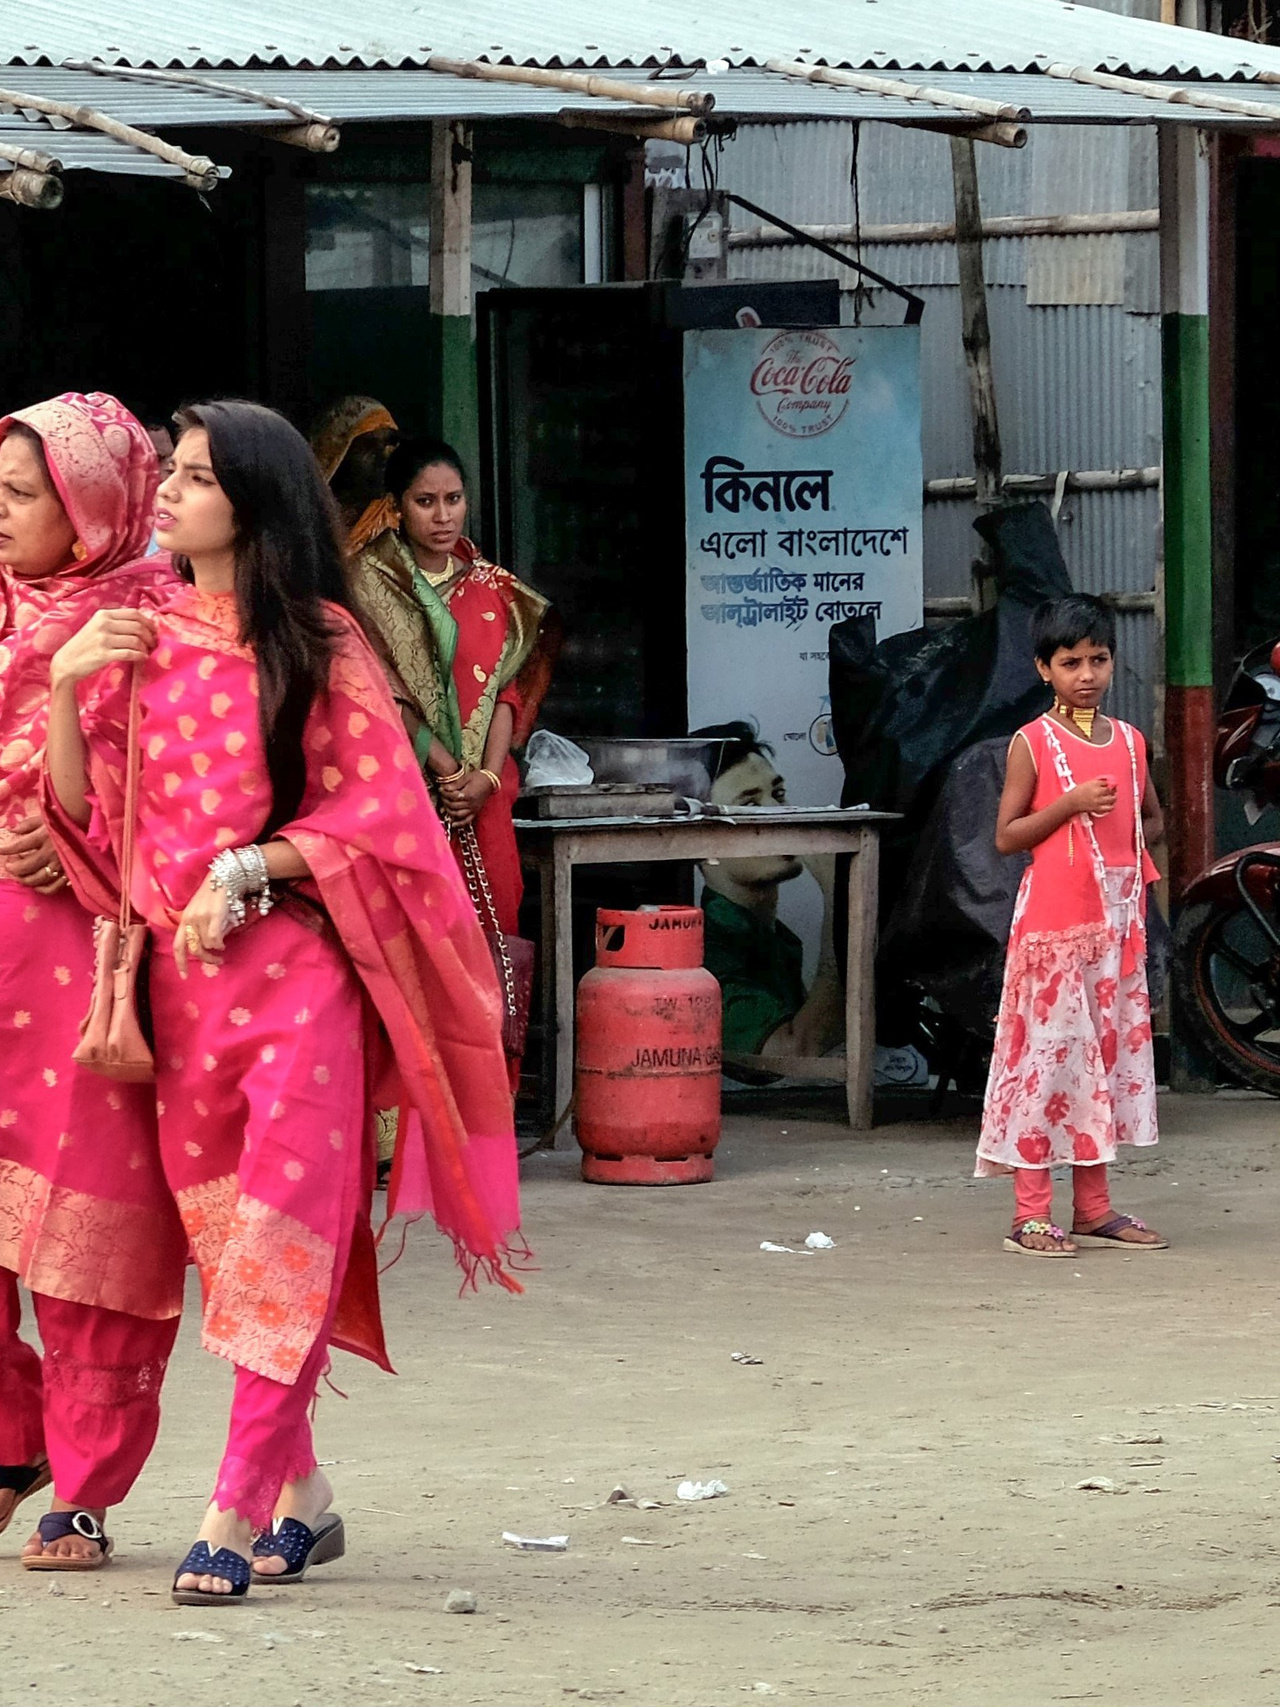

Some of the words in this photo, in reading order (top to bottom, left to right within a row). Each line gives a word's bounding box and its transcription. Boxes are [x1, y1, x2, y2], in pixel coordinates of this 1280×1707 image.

[777, 397, 831, 413] Company
[801, 414, 834, 434] TRUST
[700, 455, 834, 513] কিনলে
[700, 529, 768, 559] এলো
[777, 526, 909, 556] বাংলাদেশে
[700, 567, 807, 594] আন্তর্জাতিক
[813, 572, 865, 592] মানের
[815, 601, 882, 621] বোতলে
[631, 1046, 702, 1068] JAMUNA
[705, 1045, 721, 1065] GA
